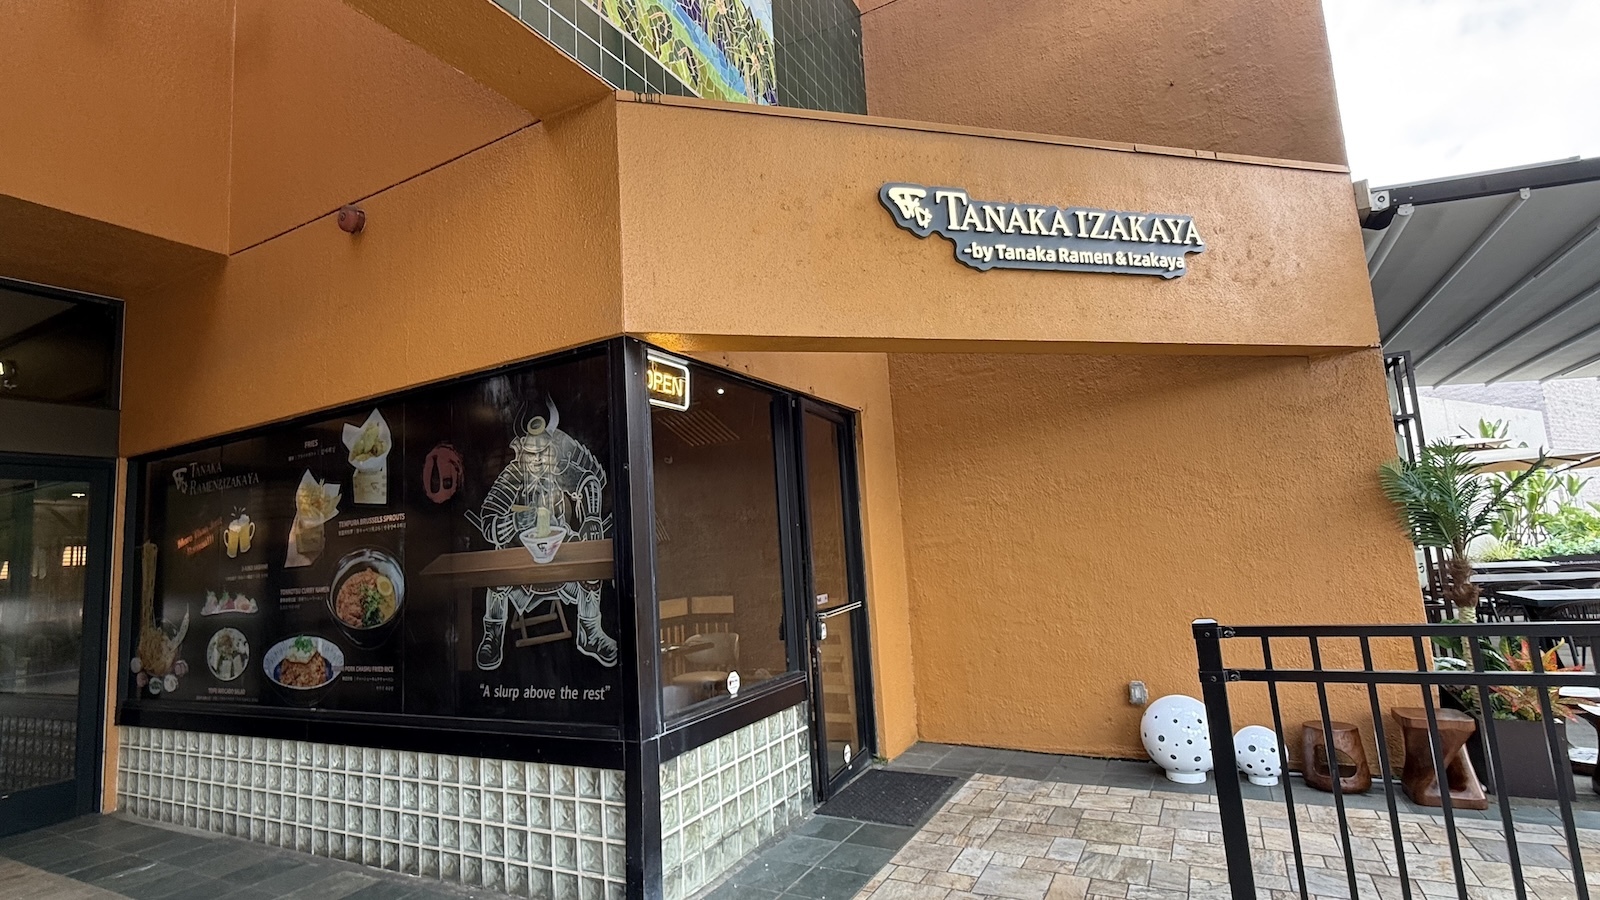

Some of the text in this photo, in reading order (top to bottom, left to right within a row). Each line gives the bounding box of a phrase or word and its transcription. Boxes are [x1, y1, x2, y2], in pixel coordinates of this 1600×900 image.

[935, 191, 1204, 246] TANAKA IZAKAYA
[994, 244, 1056, 263] Tanaka
[1058, 248, 1114, 266] Ramen
[1115, 251, 1127, 266] &
[1128, 252, 1186, 272] Izakaya
[382, 513, 406, 522] SPROUTS
[494, 684, 520, 702] slurp
[523, 685, 556, 699] above
[560, 685, 579, 700] the
